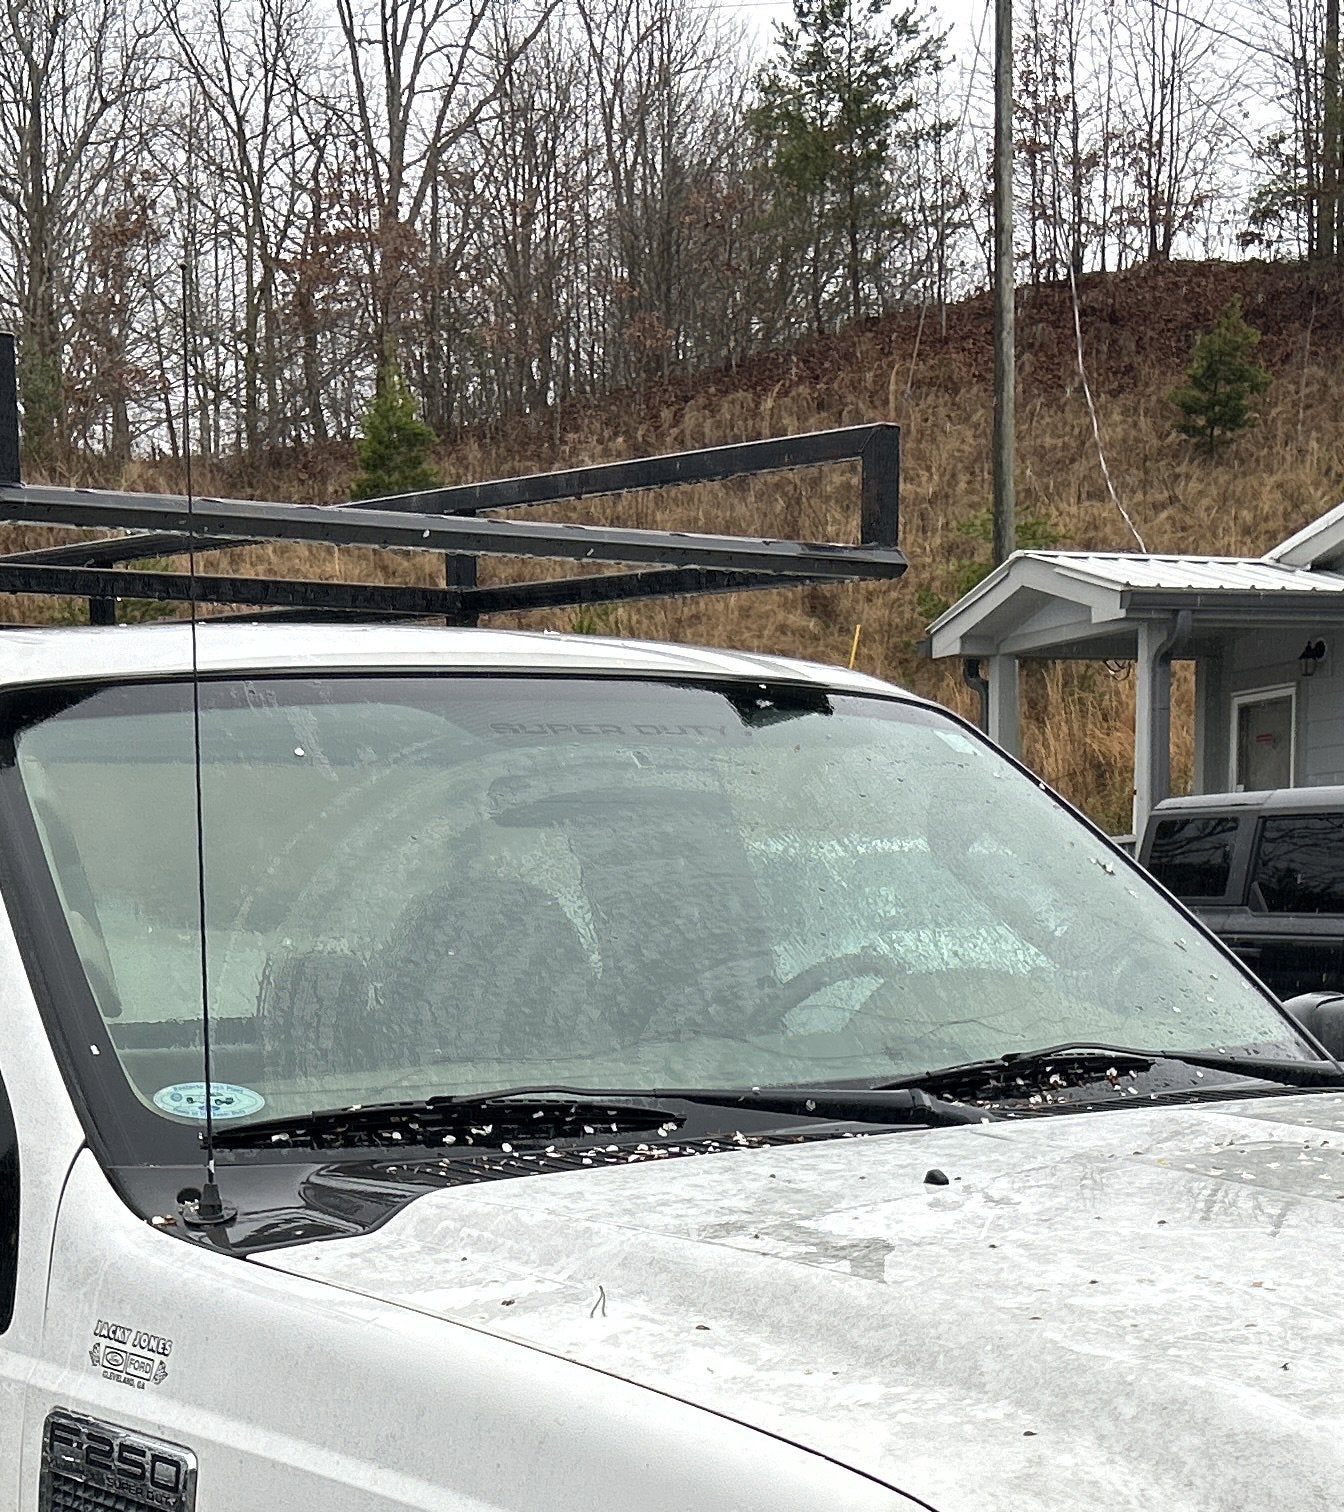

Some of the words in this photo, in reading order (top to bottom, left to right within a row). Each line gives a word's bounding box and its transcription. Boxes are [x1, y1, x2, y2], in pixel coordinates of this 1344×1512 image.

[93, 1319, 133, 1345] JACKY
[131, 1330, 174, 1357] JONES
[128, 1357, 152, 1375] FORD
